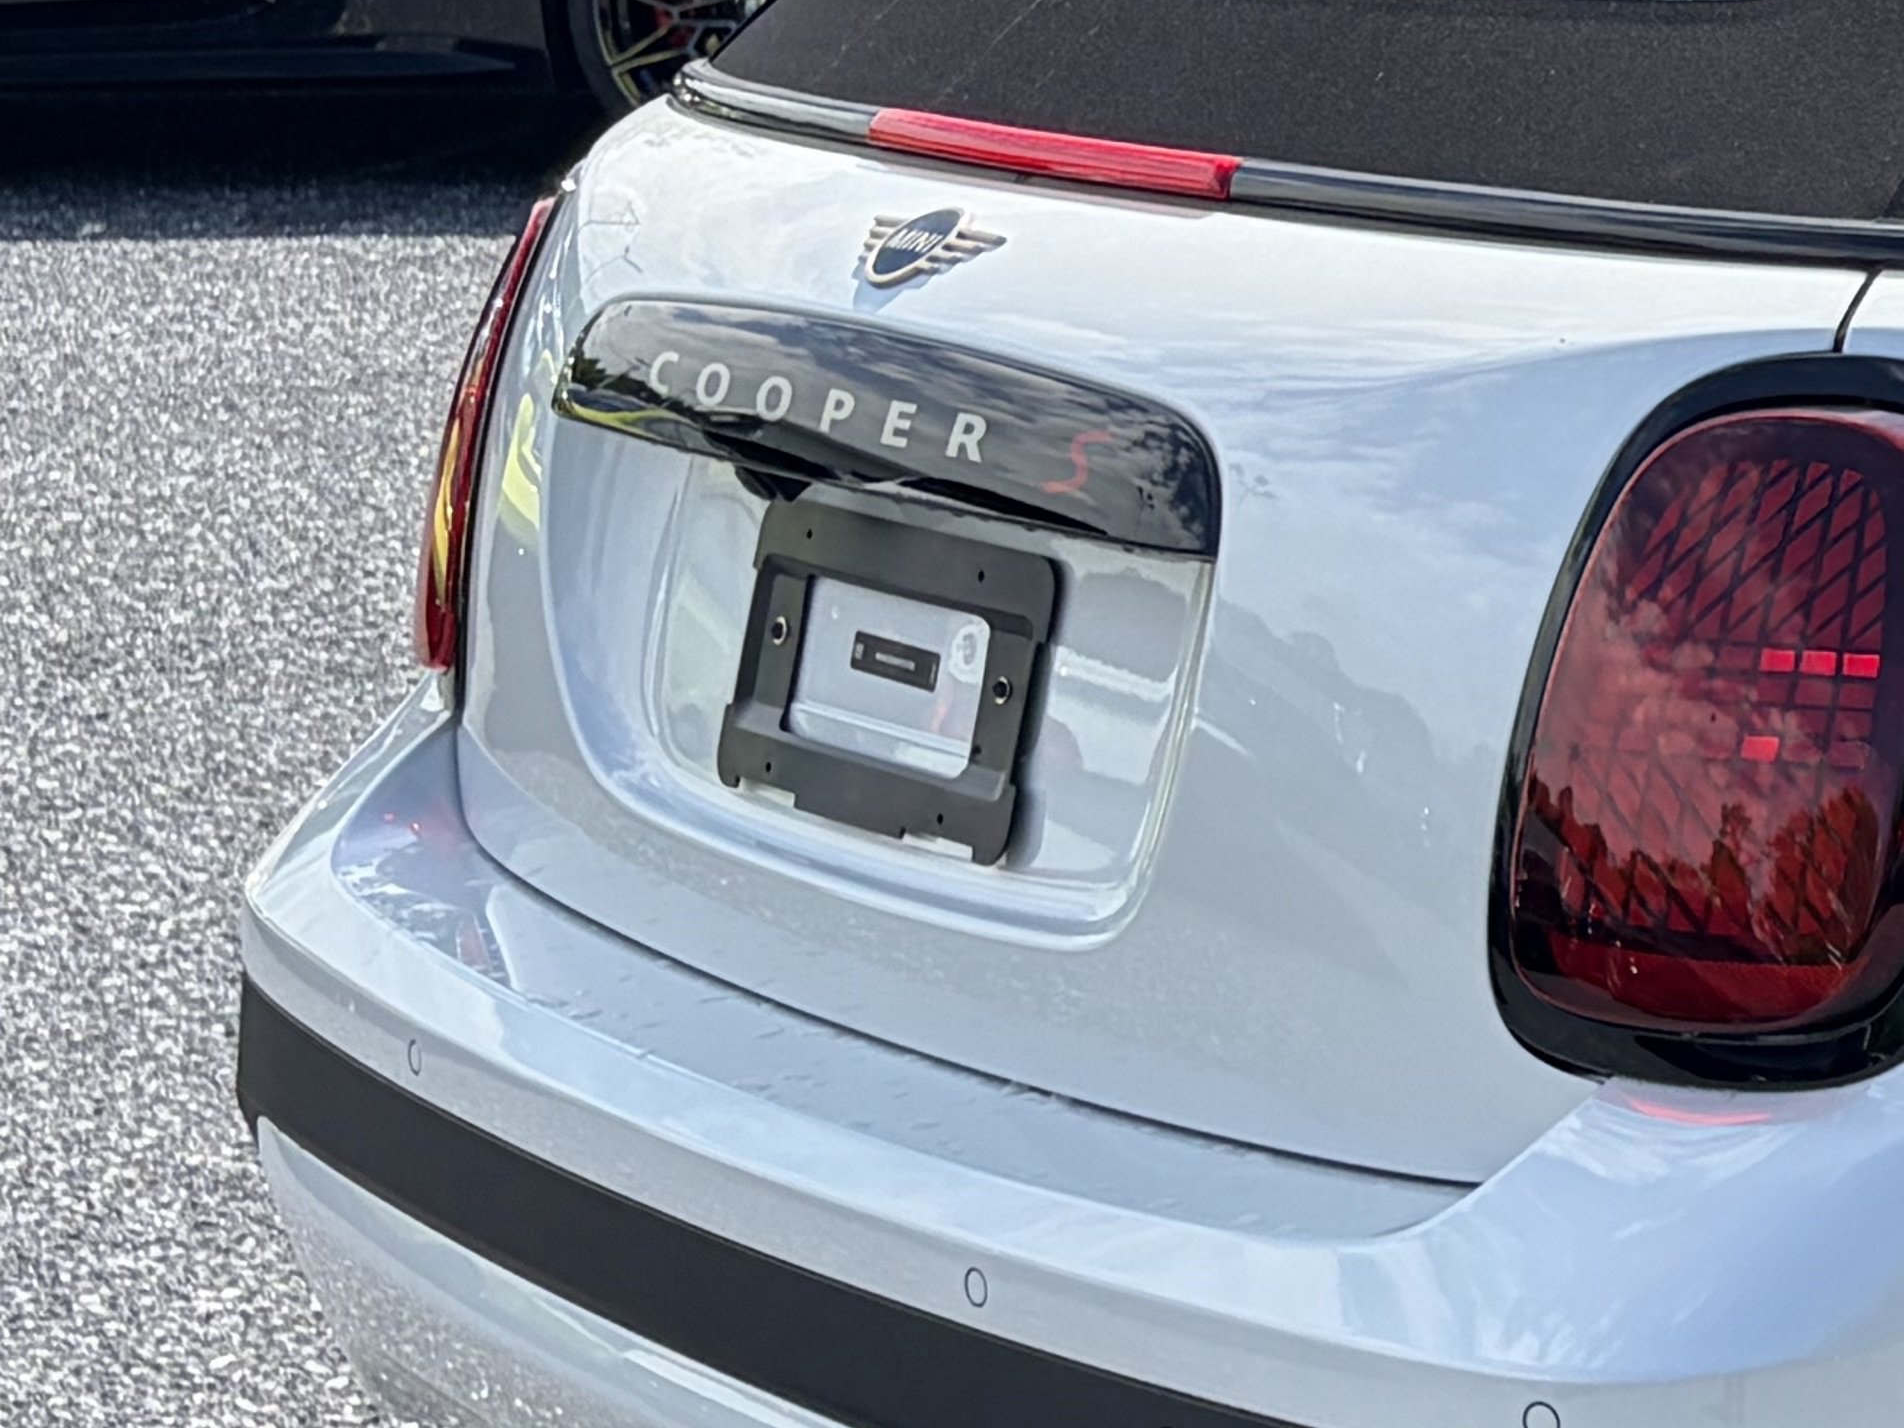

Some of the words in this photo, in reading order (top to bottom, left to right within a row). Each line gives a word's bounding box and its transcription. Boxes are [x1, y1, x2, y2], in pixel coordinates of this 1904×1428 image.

[885, 226, 944, 254] MINI
[648, 350, 989, 464] COOPER
[1040, 428, 1111, 494] S
